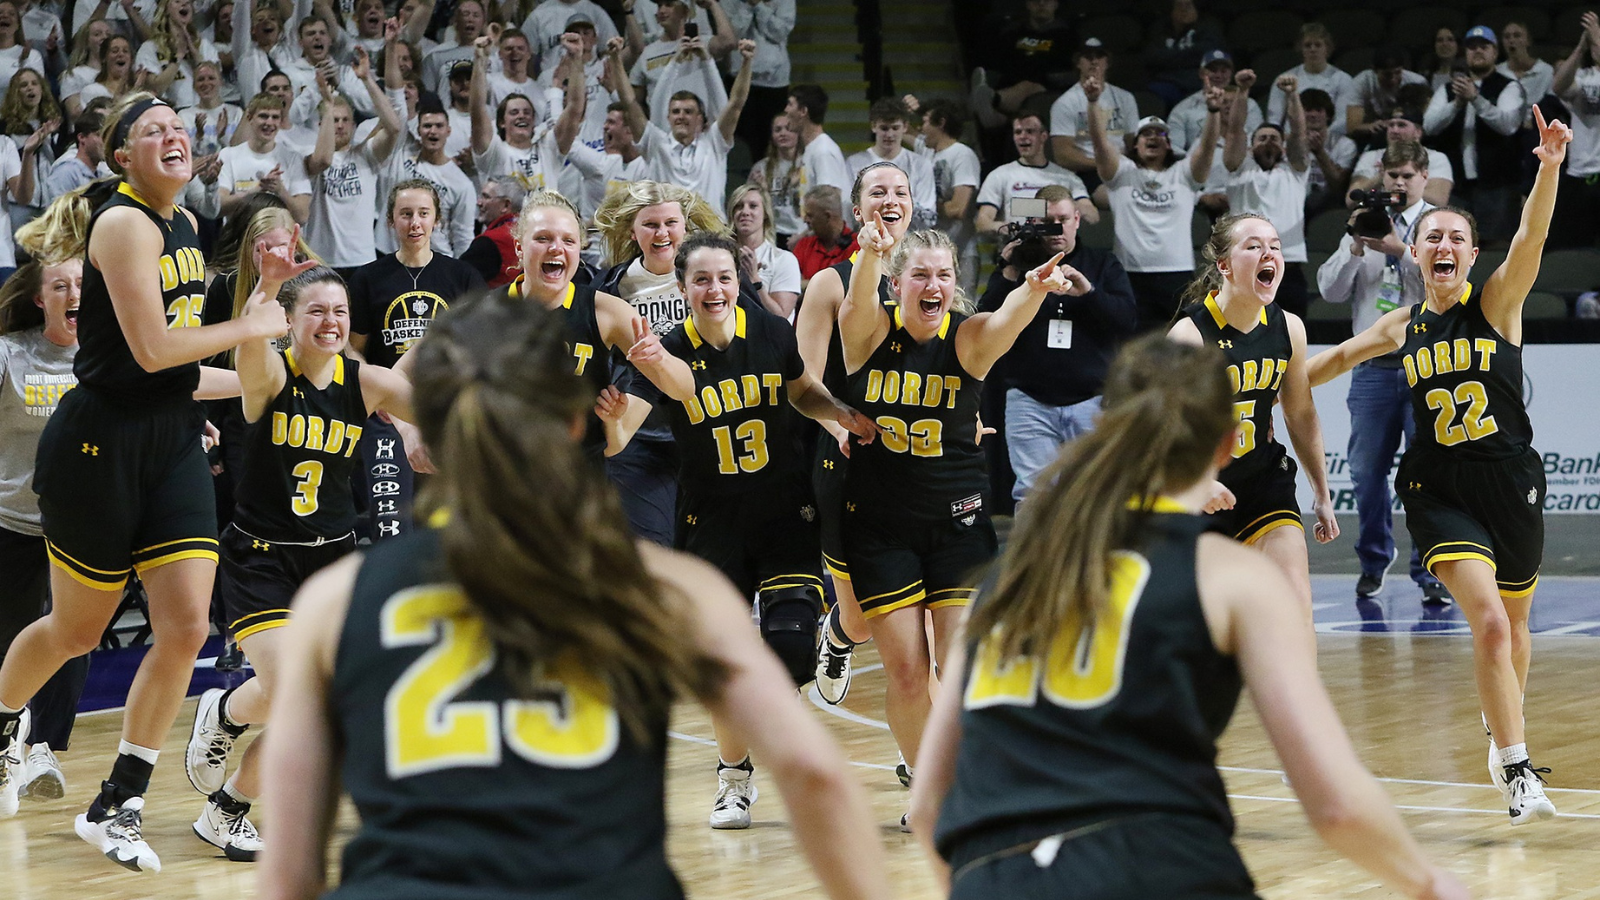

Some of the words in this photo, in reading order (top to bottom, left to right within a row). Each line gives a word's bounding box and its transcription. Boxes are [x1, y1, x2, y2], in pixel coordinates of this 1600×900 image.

[394, 320, 431, 329] DEFEN
[1225, 357, 1288, 396] ORDT
[1402, 338, 1497, 388] DORDT
[682, 373, 782, 425] DORDT
[865, 369, 961, 409] DORDT
[1425, 381, 1499, 446] 22
[272, 411, 363, 458] DORDT
[712, 419, 769, 475] 13
[291, 460, 324, 517] 3
